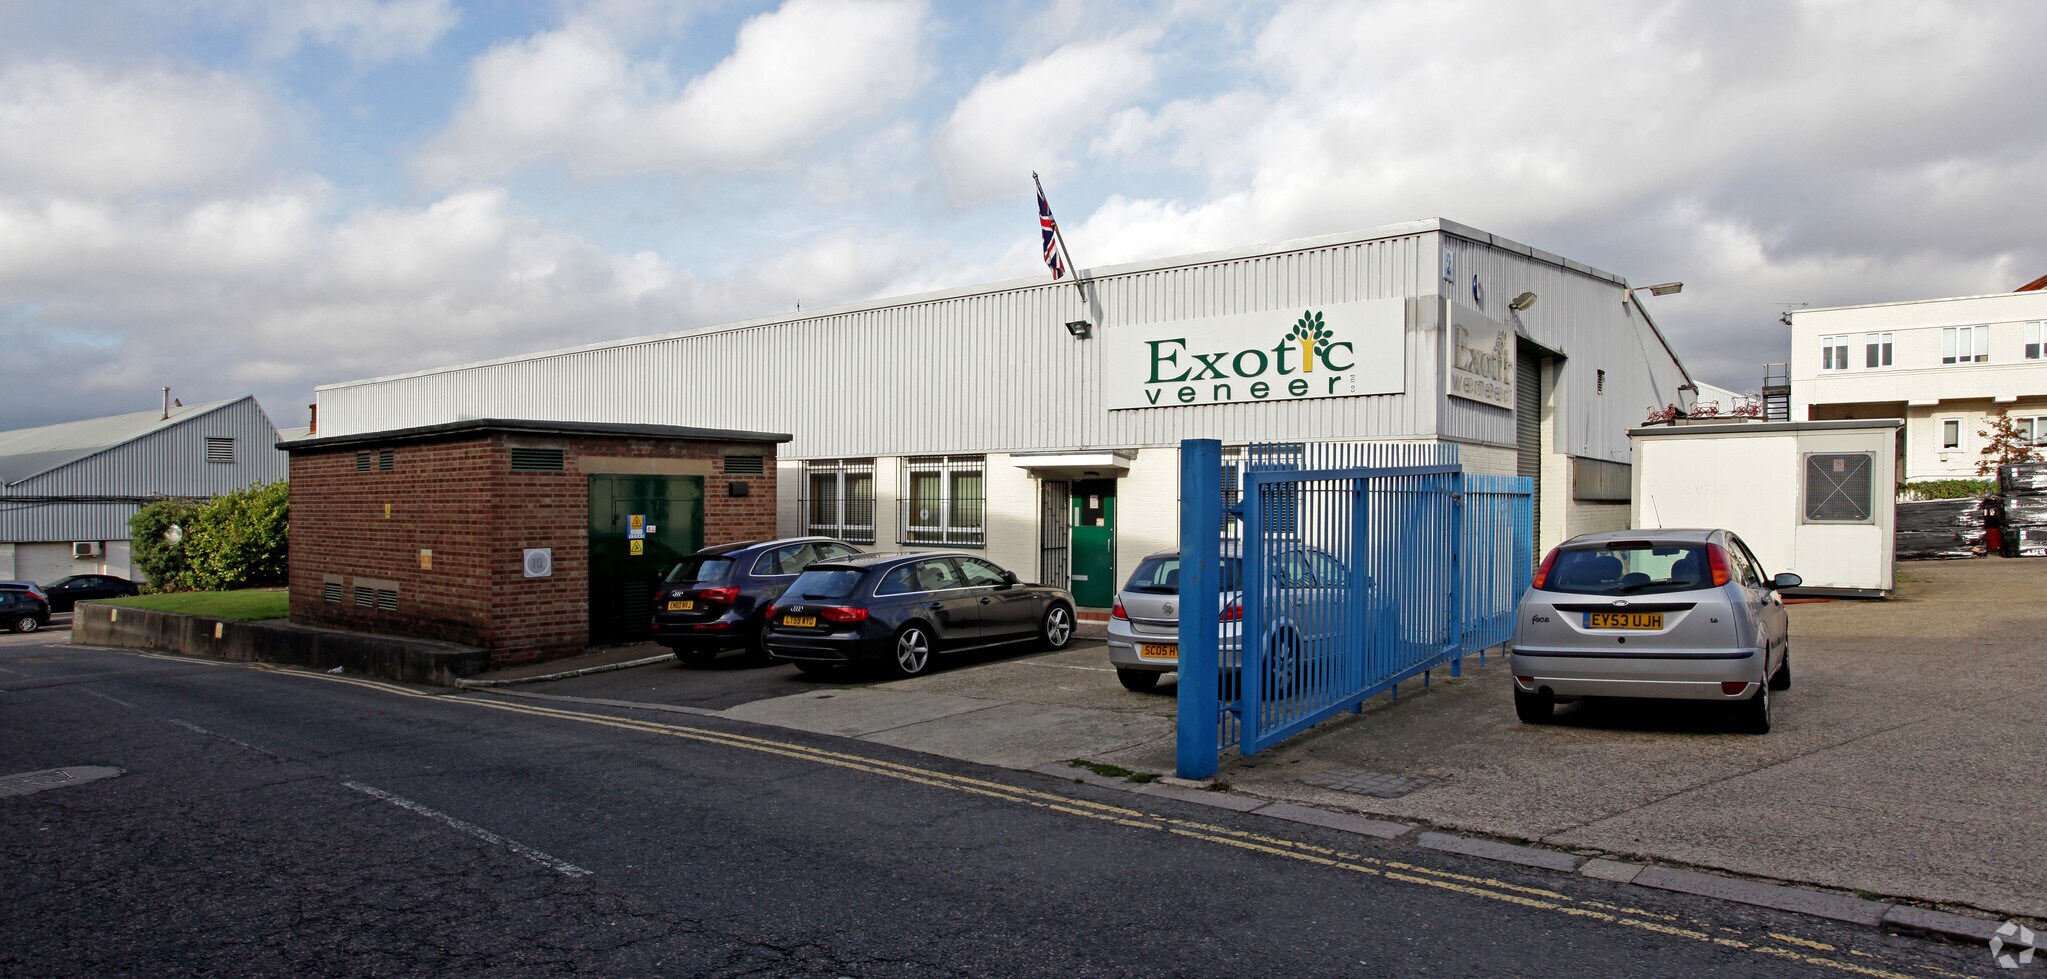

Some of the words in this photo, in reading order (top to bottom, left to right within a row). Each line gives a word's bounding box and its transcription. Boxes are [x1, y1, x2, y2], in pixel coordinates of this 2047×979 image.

[1144, 325, 1355, 384] Exotic
[1145, 375, 1342, 405] veneer
[532, 557, 543, 569] 10
[1592, 613, 1629, 626] EY53
[1632, 614, 1661, 627] UJH
[1144, 645, 1168, 656] SC05
